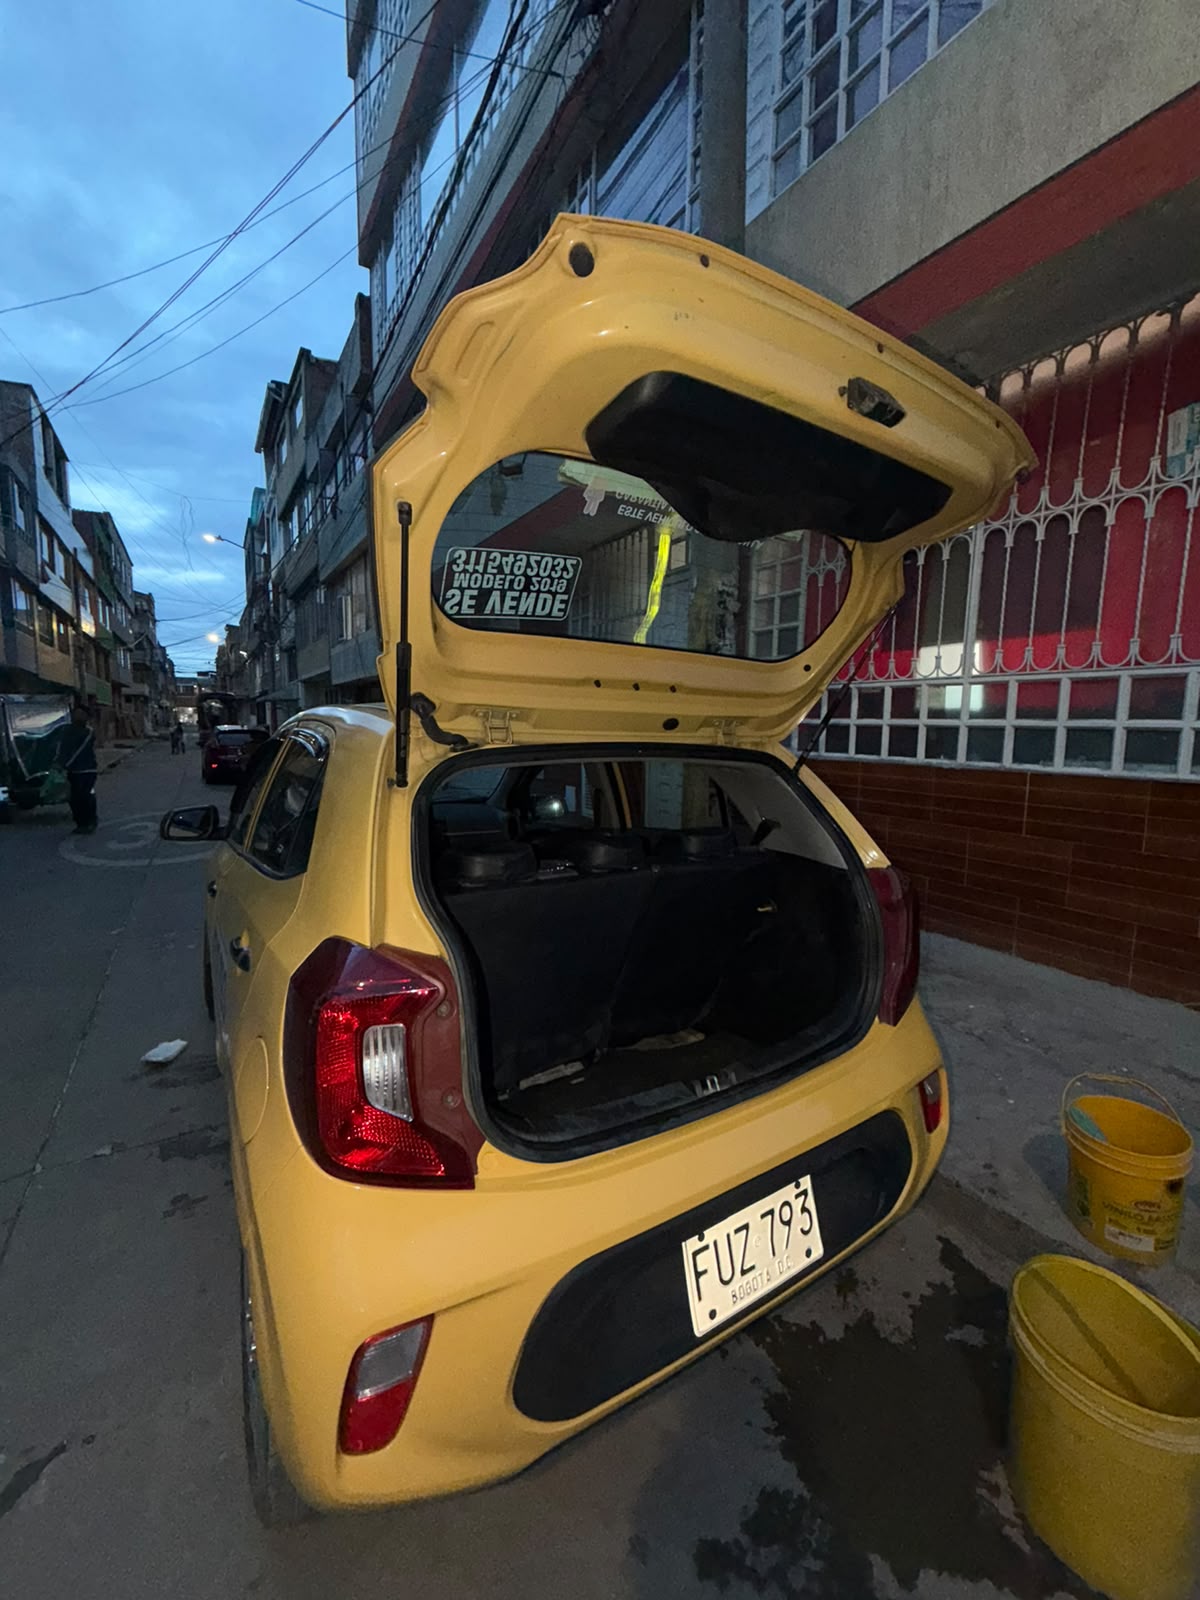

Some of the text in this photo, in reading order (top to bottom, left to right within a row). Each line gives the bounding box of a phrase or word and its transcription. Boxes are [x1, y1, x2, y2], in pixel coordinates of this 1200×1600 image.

[691, 1188, 813, 1303] FUZ 793
[731, 1268, 771, 1304] BOGOTA
